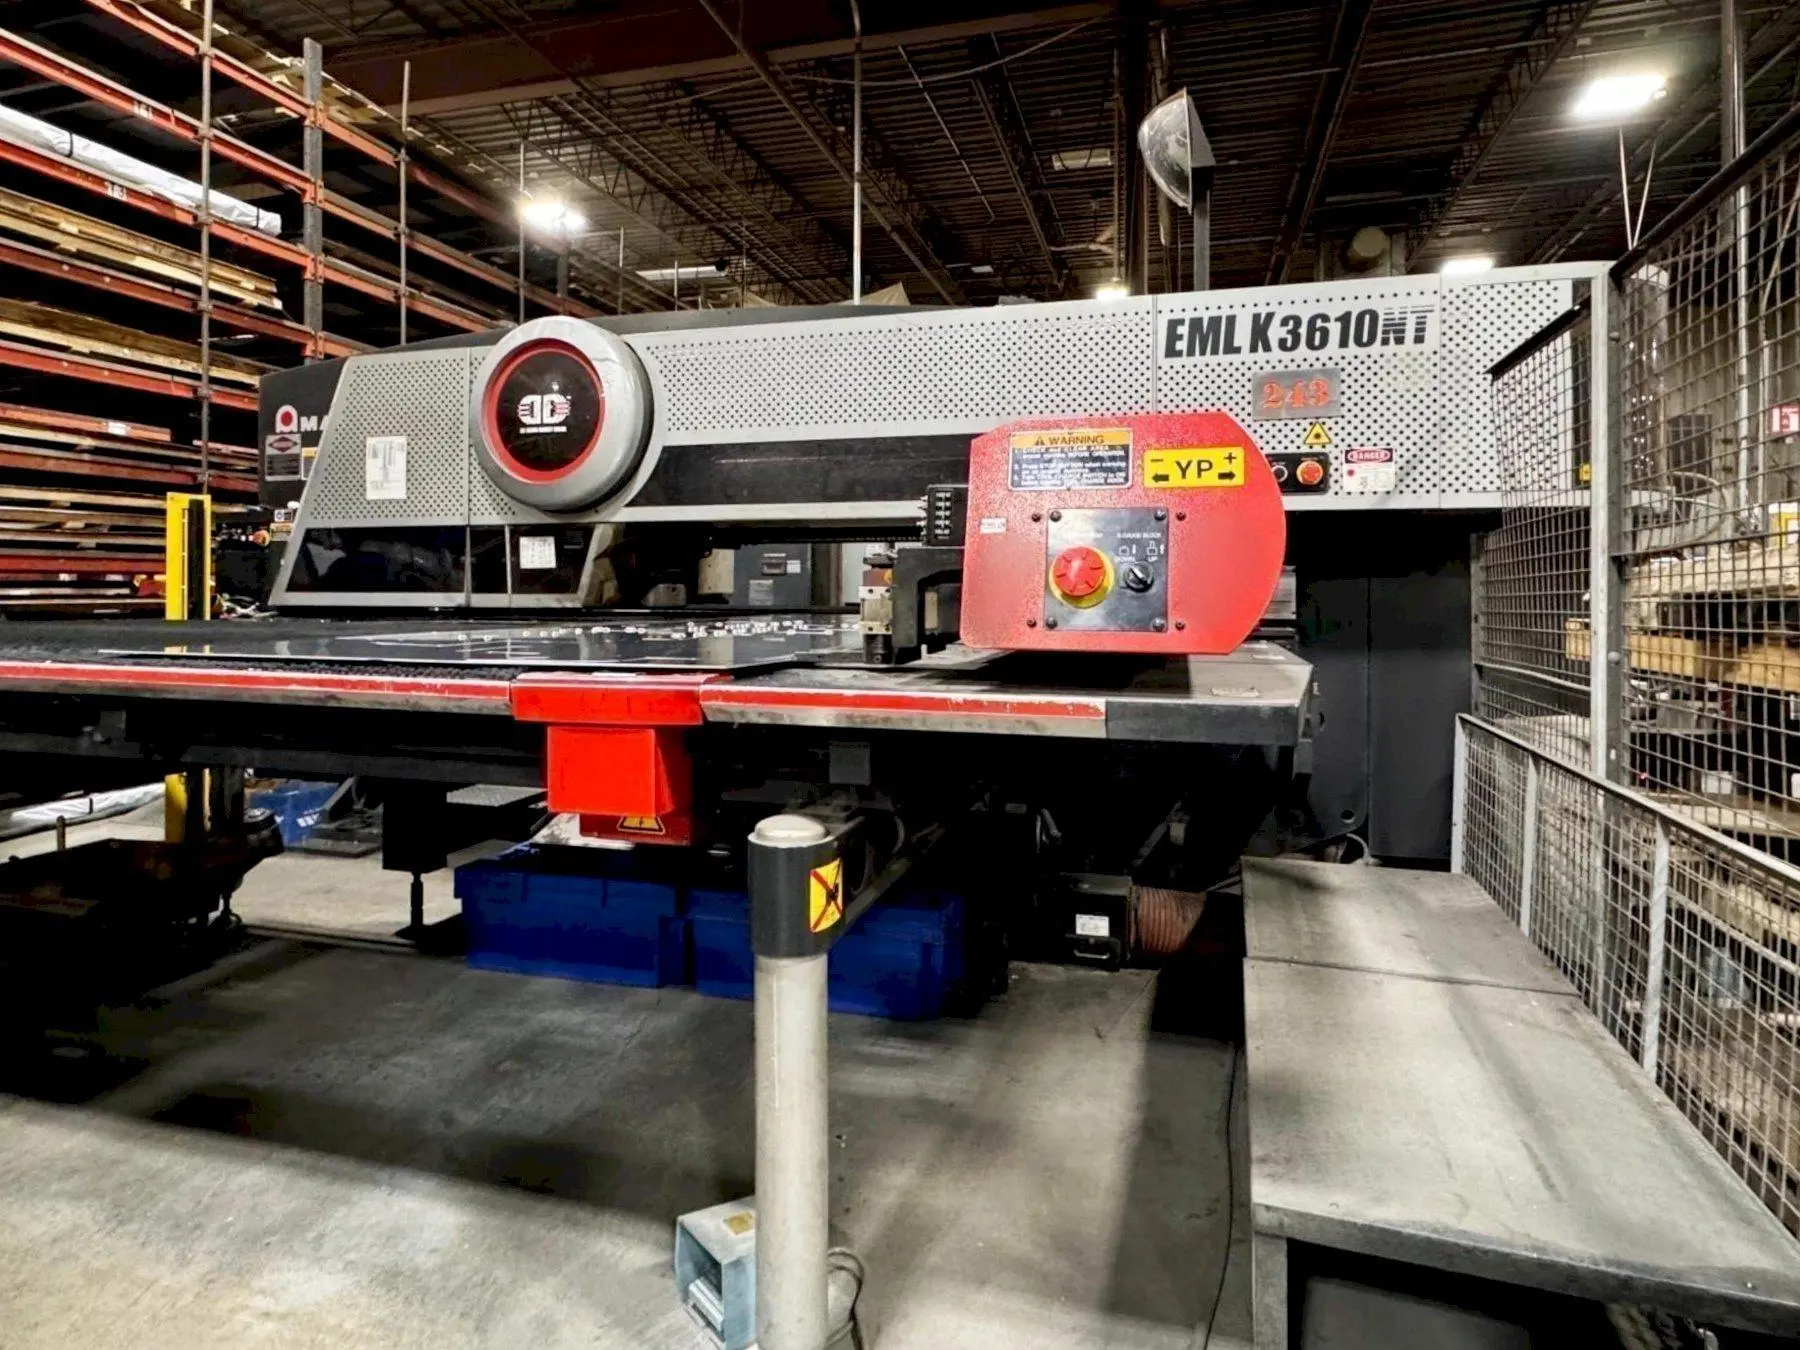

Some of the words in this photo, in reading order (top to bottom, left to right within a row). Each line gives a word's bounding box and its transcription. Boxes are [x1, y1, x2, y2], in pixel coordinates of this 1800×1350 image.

[1164, 314, 1242, 359] EML
[1249, 305, 1435, 353] K3610NT
[1262, 377, 1333, 409] 243
[1048, 435, 1104, 446] WARNING
[1353, 451, 1384, 461] DANGER
[1174, 460, 1213, 480] YP
